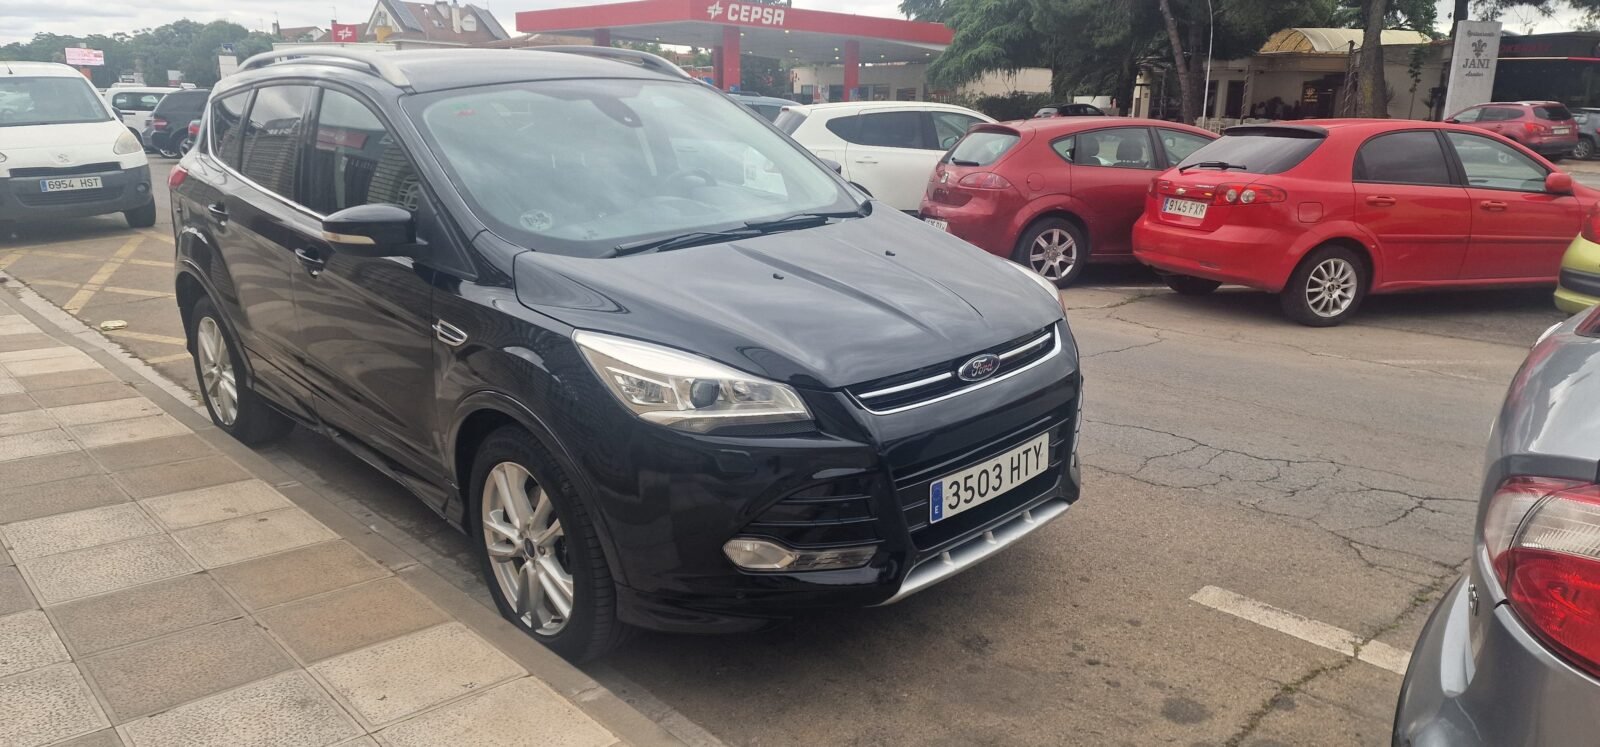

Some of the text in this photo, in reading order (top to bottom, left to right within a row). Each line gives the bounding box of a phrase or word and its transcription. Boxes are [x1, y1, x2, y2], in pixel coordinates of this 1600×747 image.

[727, 3, 785, 25] CEPSA
[1462, 58, 1490, 69] JANI
[47, 178, 99, 190] 6954 HST
[1168, 199, 1205, 215] 9145 FXR
[971, 358, 994, 377] Ford
[947, 441, 1043, 510] 3503 HTY
[934, 505, 939, 514] E
